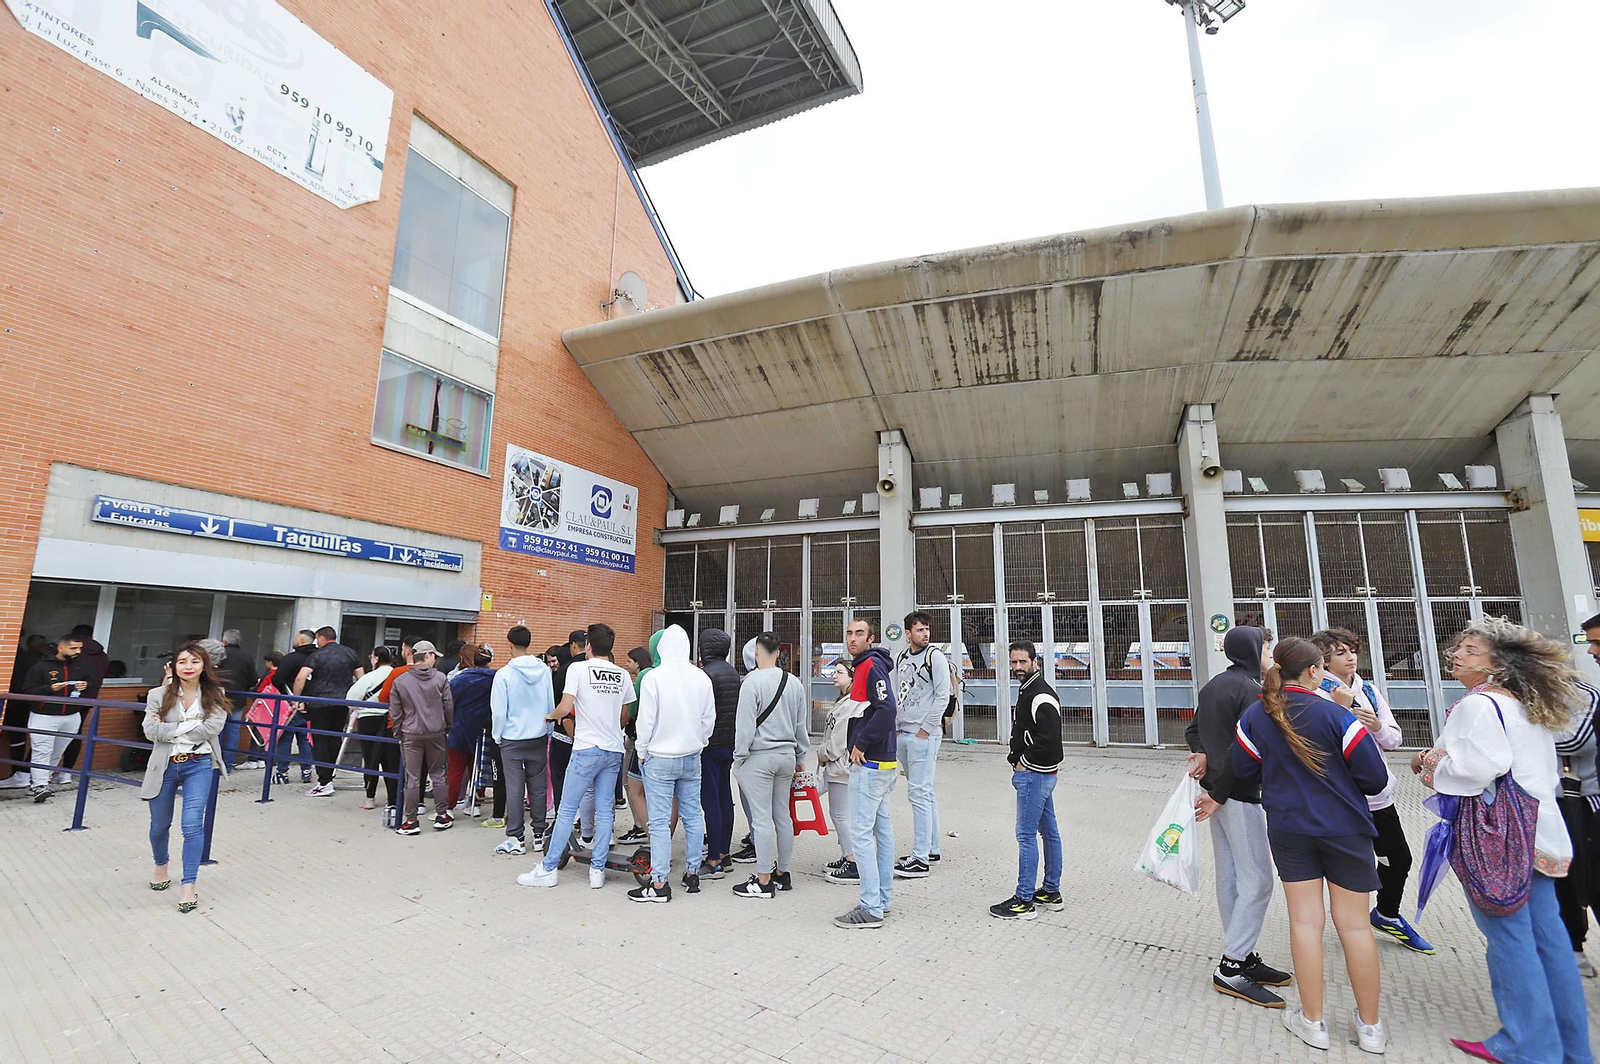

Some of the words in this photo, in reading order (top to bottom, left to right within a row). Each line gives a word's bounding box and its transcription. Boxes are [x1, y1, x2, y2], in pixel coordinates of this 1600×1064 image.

[20, 0, 95, 46] XTINTORES
[174, 11, 276, 86] SEGURIDAD
[37, 22, 52, 36] La
[84, 49, 112, 71] Fase
[115, 68, 123, 77] 6
[135, 79, 169, 103] Naves
[172, 101, 179, 109] 3
[182, 107, 189, 116] y
[209, 122, 244, 146] 21007
[252, 147, 281, 169] Huelva
[150, 76, 200, 109] ALARMAS
[280, 84, 310, 108] 959
[315, 106, 332, 125] 10
[336, 121, 353, 138] 99
[358, 135, 373, 152] 10
[266, 145, 288, 160] CCTV
[112, 500, 151, 514] Venta
[154, 508, 171, 518] de
[110, 512, 170, 529] Entradas
[273, 526, 362, 554] Taquillas
[567, 525, 593, 536] EMPRESA
[593, 531, 632, 545] CONSTRUCTORA
[417, 550, 439, 558] Salida
[522, 543, 578, 560] info@clauypaul.es
[524, 534, 541, 545] 959
[543, 538, 554, 547] 87
[556, 541, 567, 550] 52
[568, 543, 578, 552] 41
[585, 547, 600, 557] 959
[601, 550, 610, 559] 61
[611, 553, 620, 561] 00
[621, 555, 630, 563] 11
[585, 557, 630, 570] www.clauypaul.es
[592, 669, 622, 683] VANS
